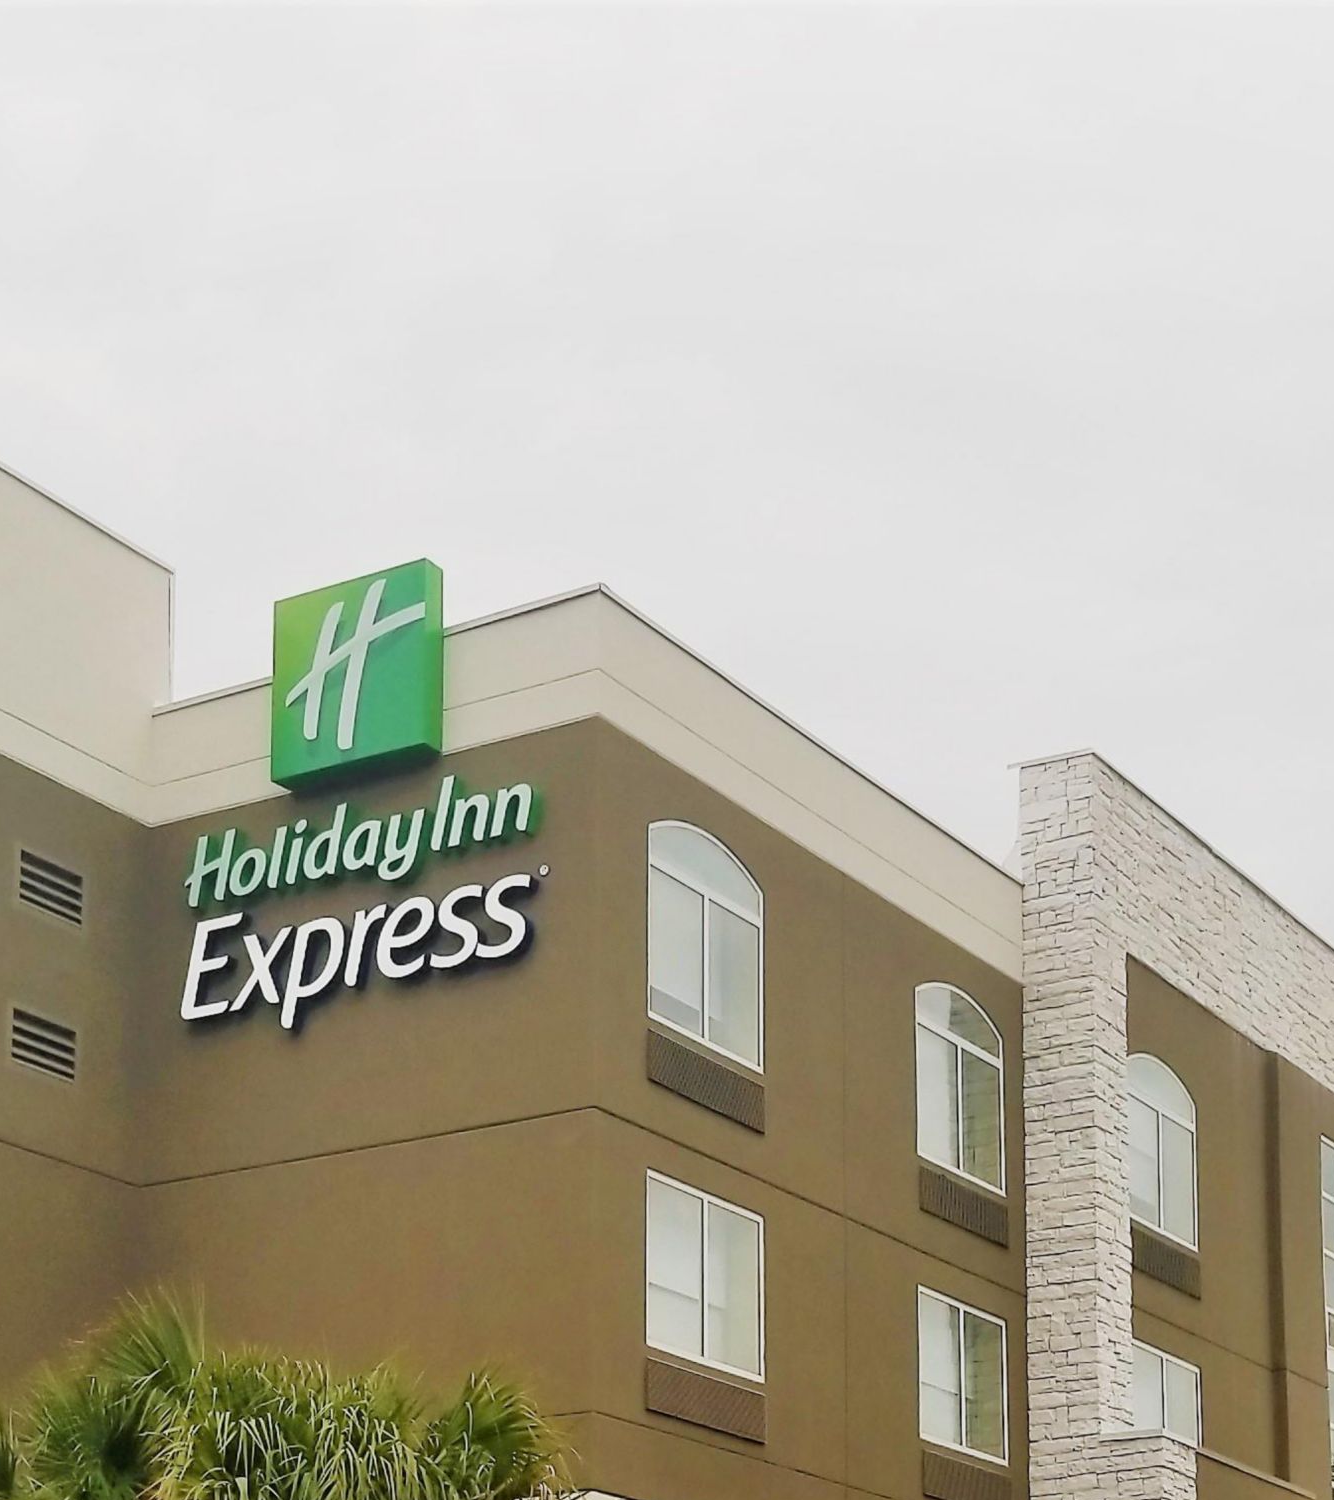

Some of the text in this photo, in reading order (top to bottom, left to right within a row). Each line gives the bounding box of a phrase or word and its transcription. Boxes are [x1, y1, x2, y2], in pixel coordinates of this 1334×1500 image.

[184, 775, 532, 908] Holiday Inn
[180, 873, 532, 1030] Express
